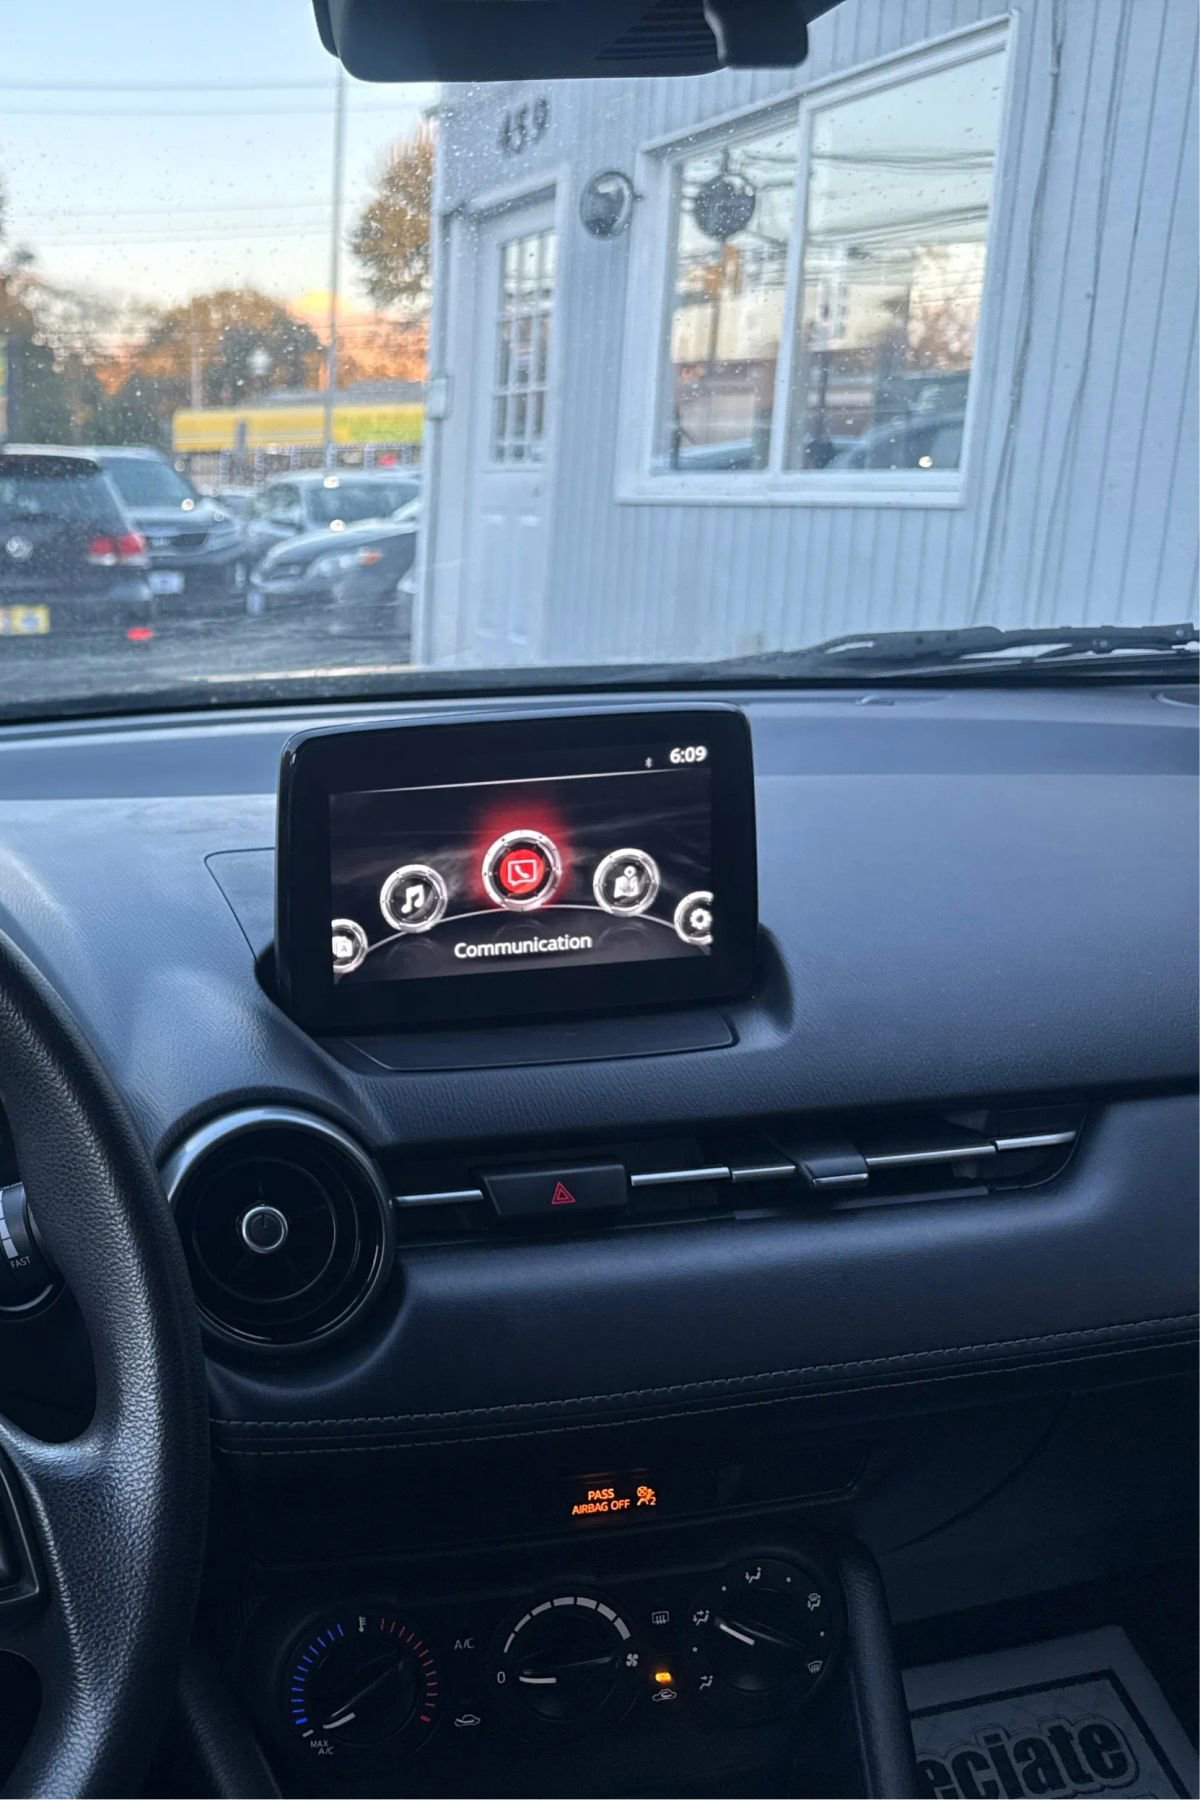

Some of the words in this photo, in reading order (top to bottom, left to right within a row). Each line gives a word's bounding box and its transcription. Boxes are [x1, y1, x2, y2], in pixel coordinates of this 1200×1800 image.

[670, 746, 707, 764] 6:09
[453, 934, 593, 960] Communication
[10, 1255, 32, 1269] FAST
[588, 1488, 615, 1501] PASS
[571, 1501, 609, 1516] AIRBAG
[610, 1499, 631, 1511] OFF
[454, 1637, 476, 1651] A/C
[496, 1671, 506, 1684] 0
[310, 1740, 329, 1749] MAX
[318, 1746, 335, 1756] A/C
